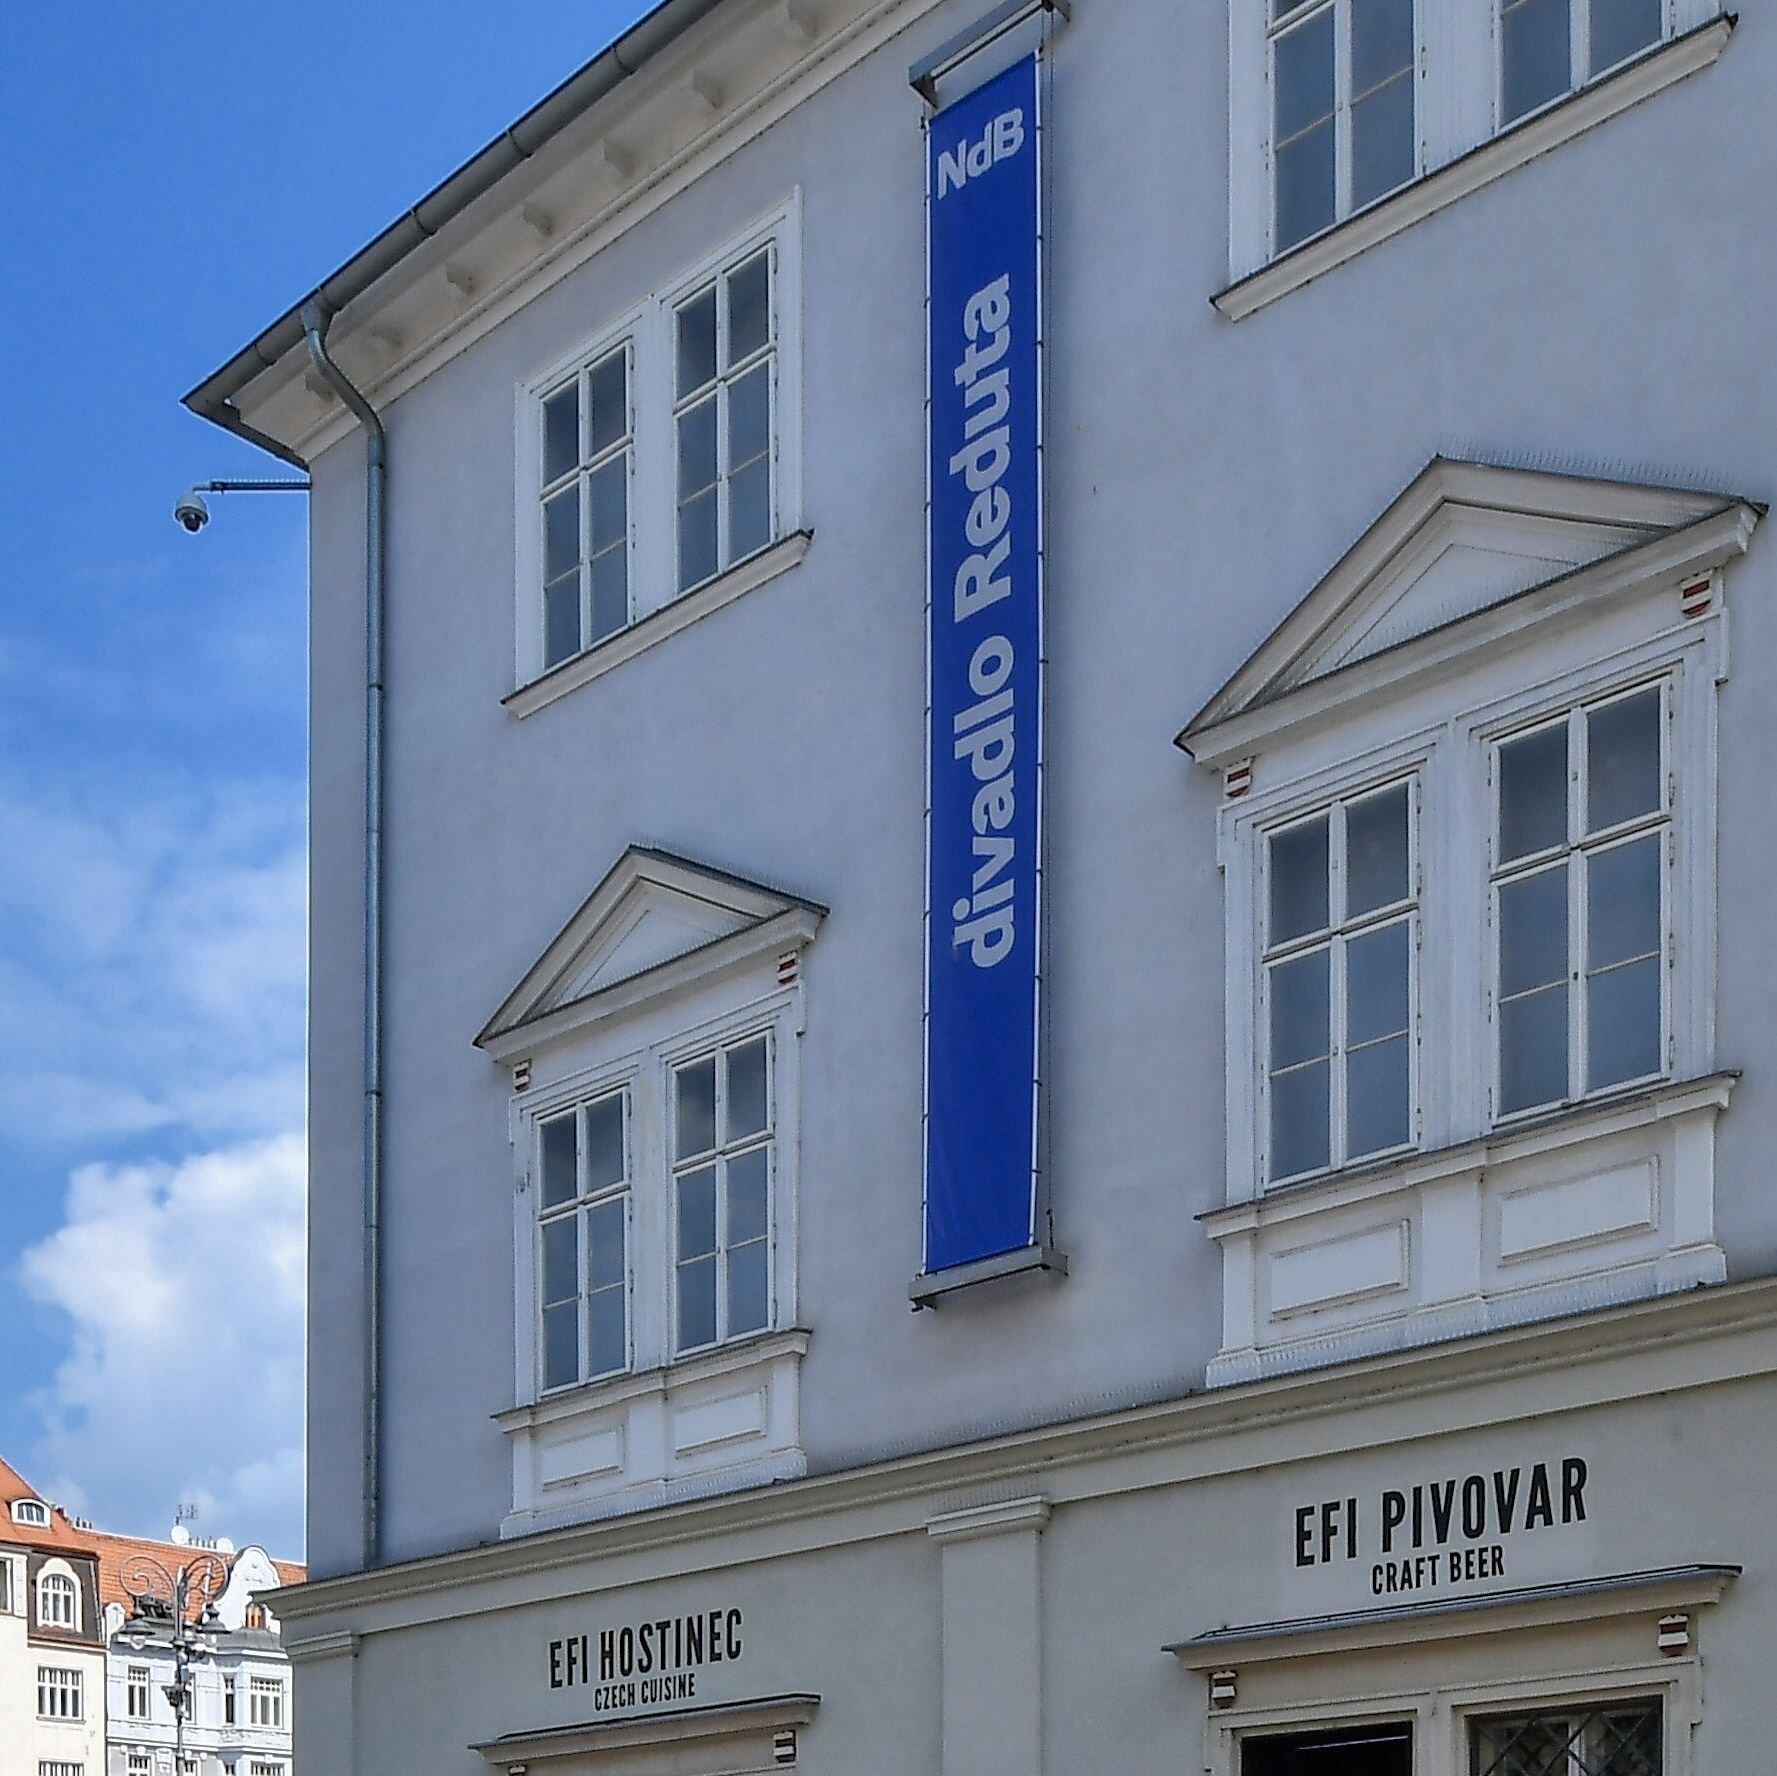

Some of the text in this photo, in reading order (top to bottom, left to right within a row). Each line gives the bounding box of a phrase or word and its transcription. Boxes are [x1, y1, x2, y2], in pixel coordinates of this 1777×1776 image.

[937, 107, 1025, 199] NdB
[949, 272, 1015, 968] divadlo Reduta
[1296, 1457, 1587, 1567] EFI PIVOVAR
[1372, 1545, 1505, 1595] CRAFT BEER
[550, 1608, 742, 1689] EFI HOSTINEC
[594, 1673, 696, 1711] CZECH CUISINE
